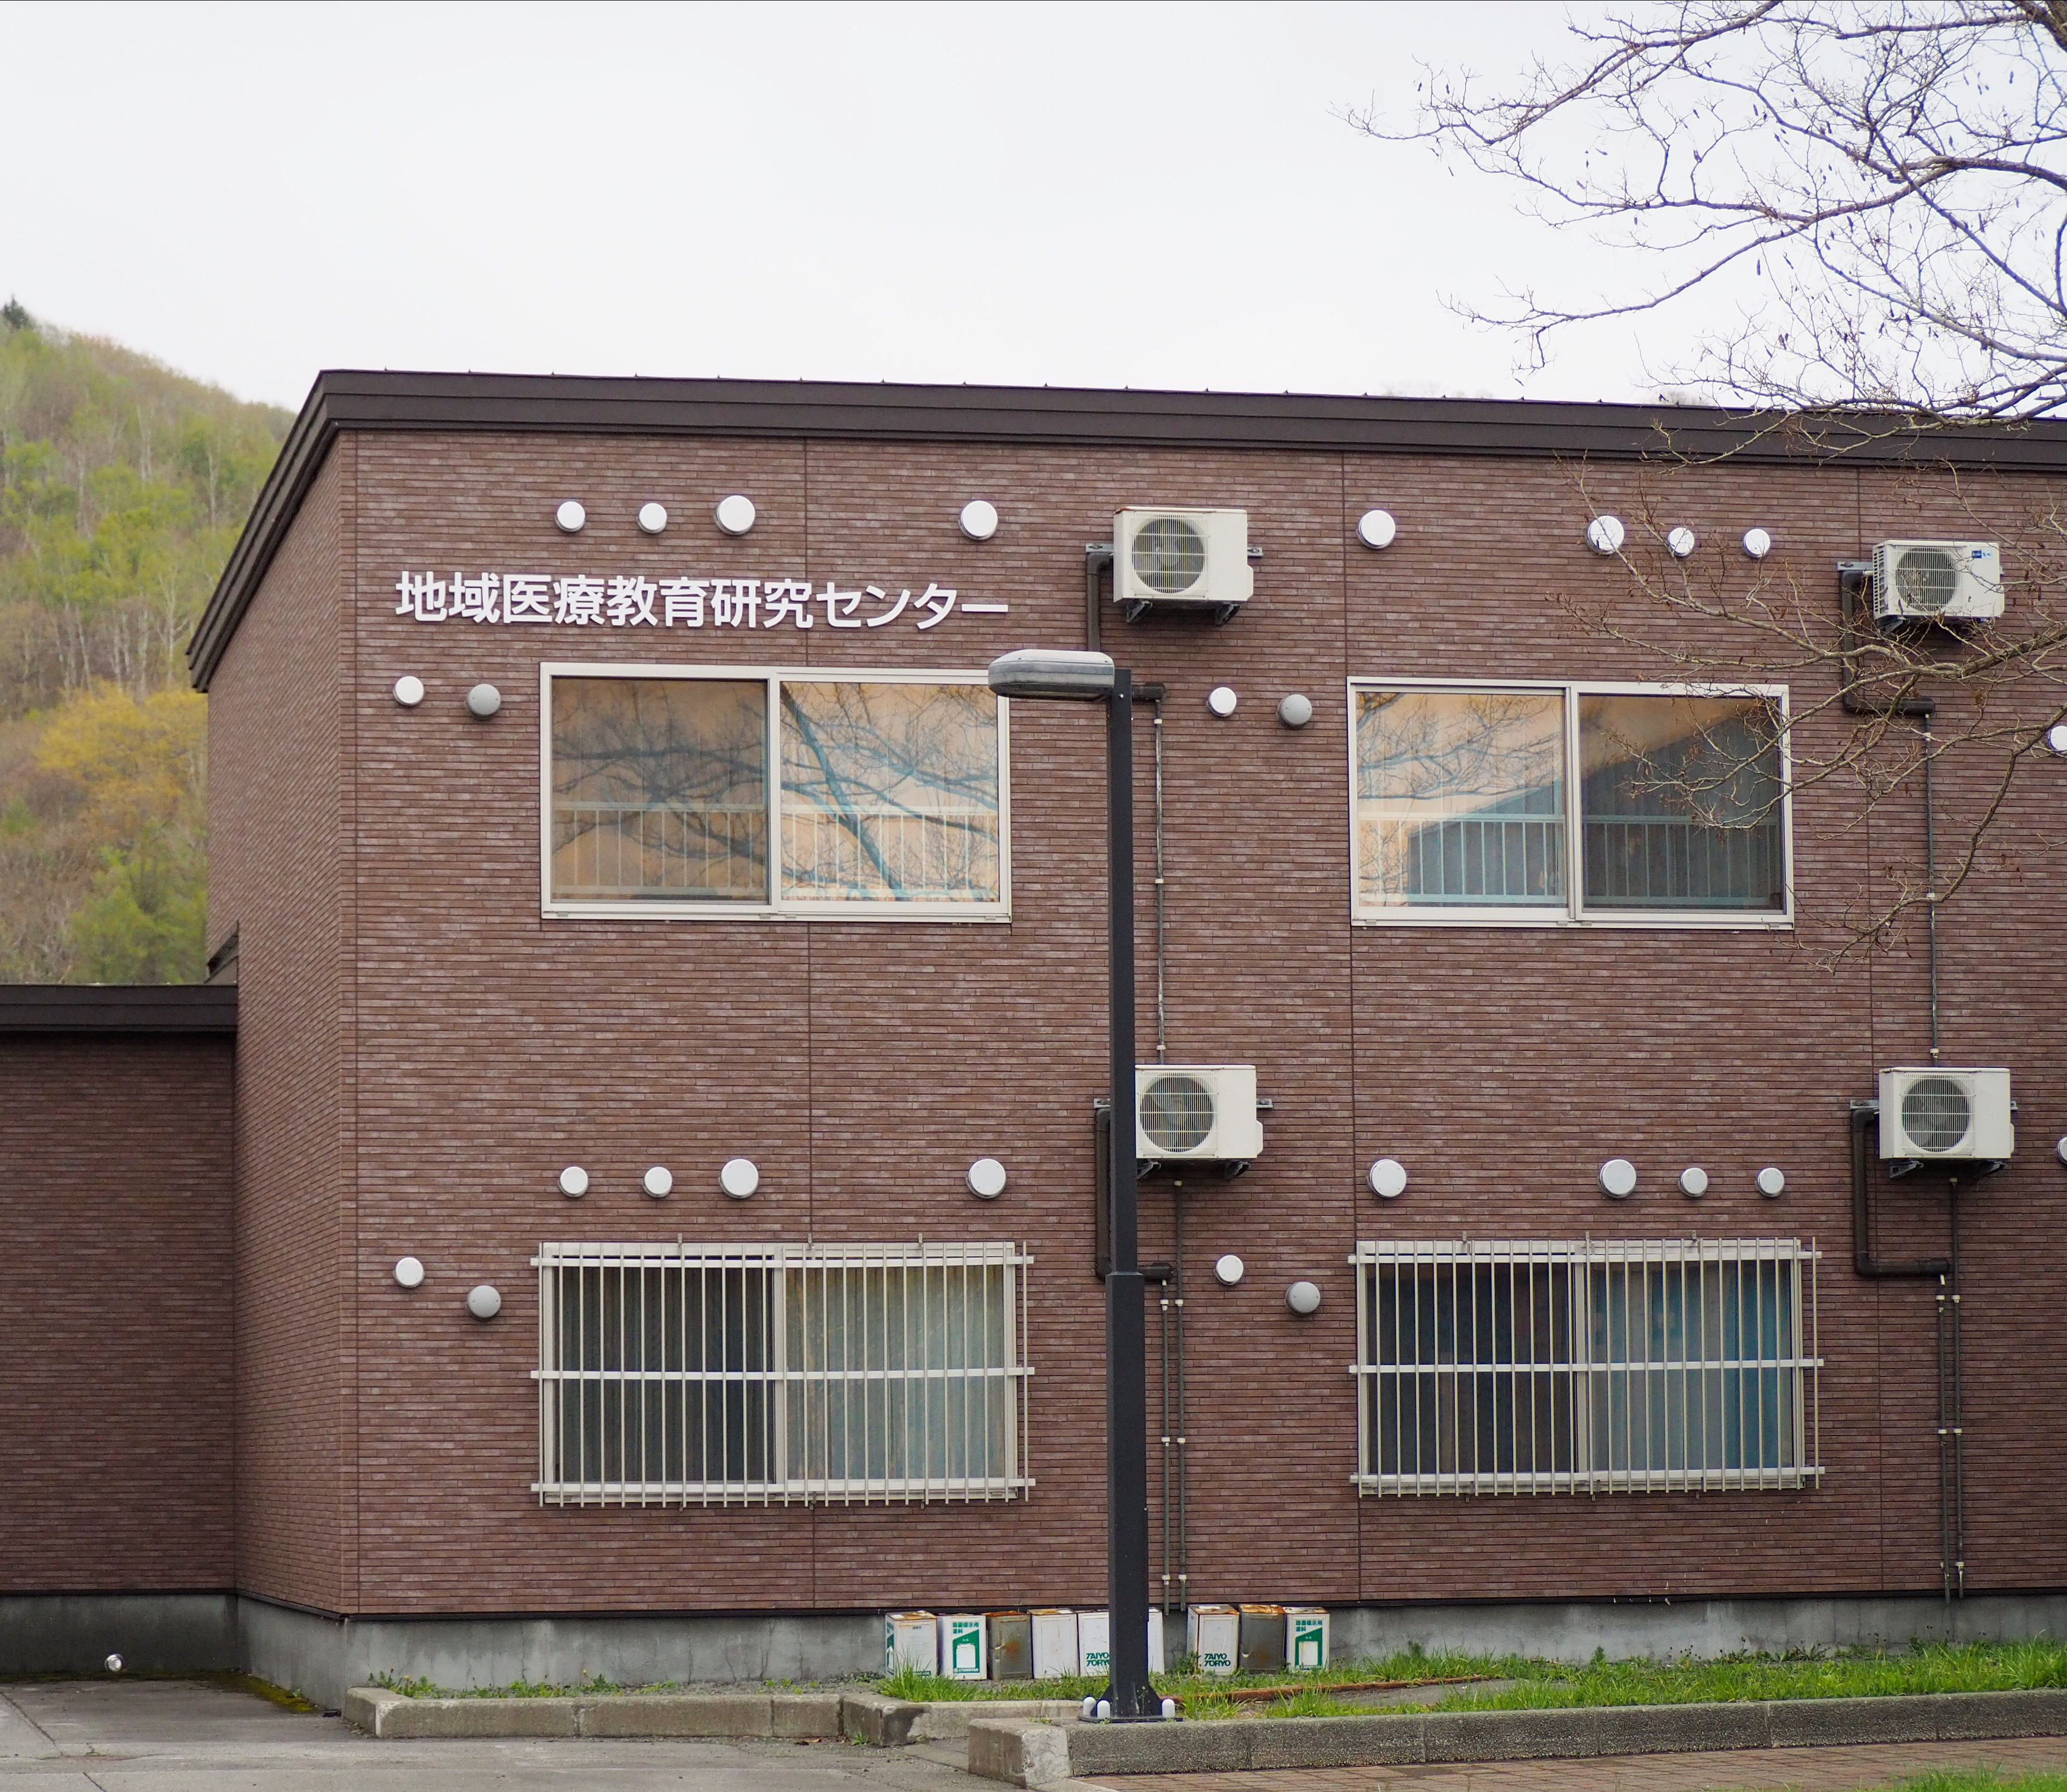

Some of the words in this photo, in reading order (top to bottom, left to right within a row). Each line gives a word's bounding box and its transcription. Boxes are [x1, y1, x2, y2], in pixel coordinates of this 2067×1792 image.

[395, 571, 1009, 630] 地域医療教育研究センター
[1086, 1652, 1109, 1660] TAIYO
